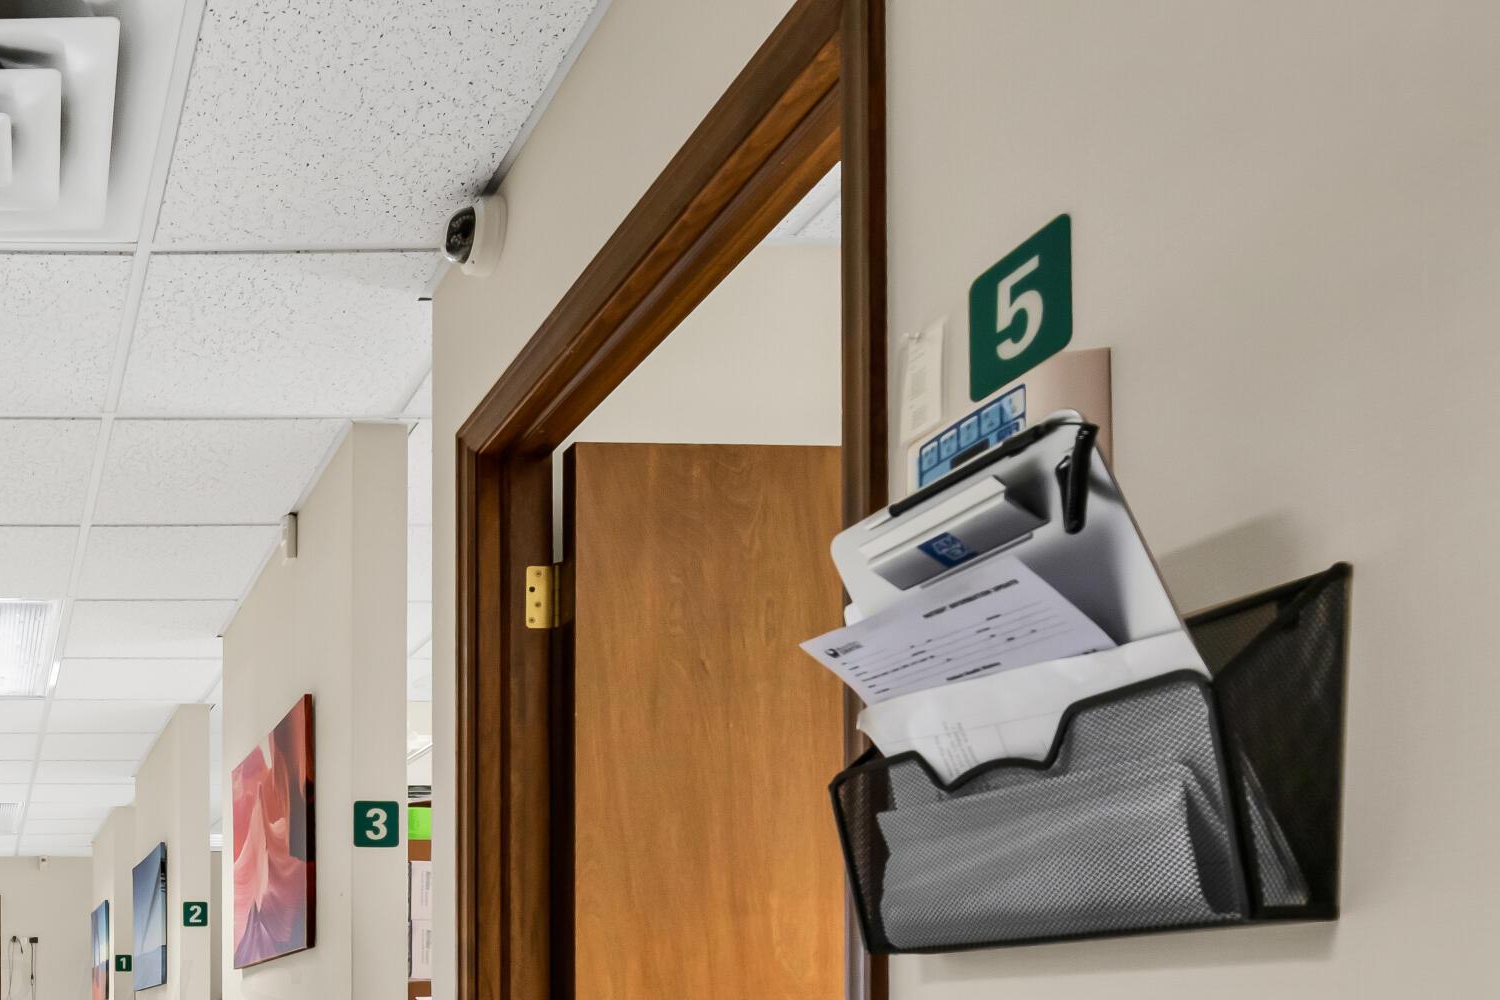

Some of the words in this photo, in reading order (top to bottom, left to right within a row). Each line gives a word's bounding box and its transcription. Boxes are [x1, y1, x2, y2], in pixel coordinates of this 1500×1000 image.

[996, 255, 1044, 360] 5
[365, 807, 388, 841] 3
[189, 905, 202, 923] 2
[119, 957, 126, 970] 1
